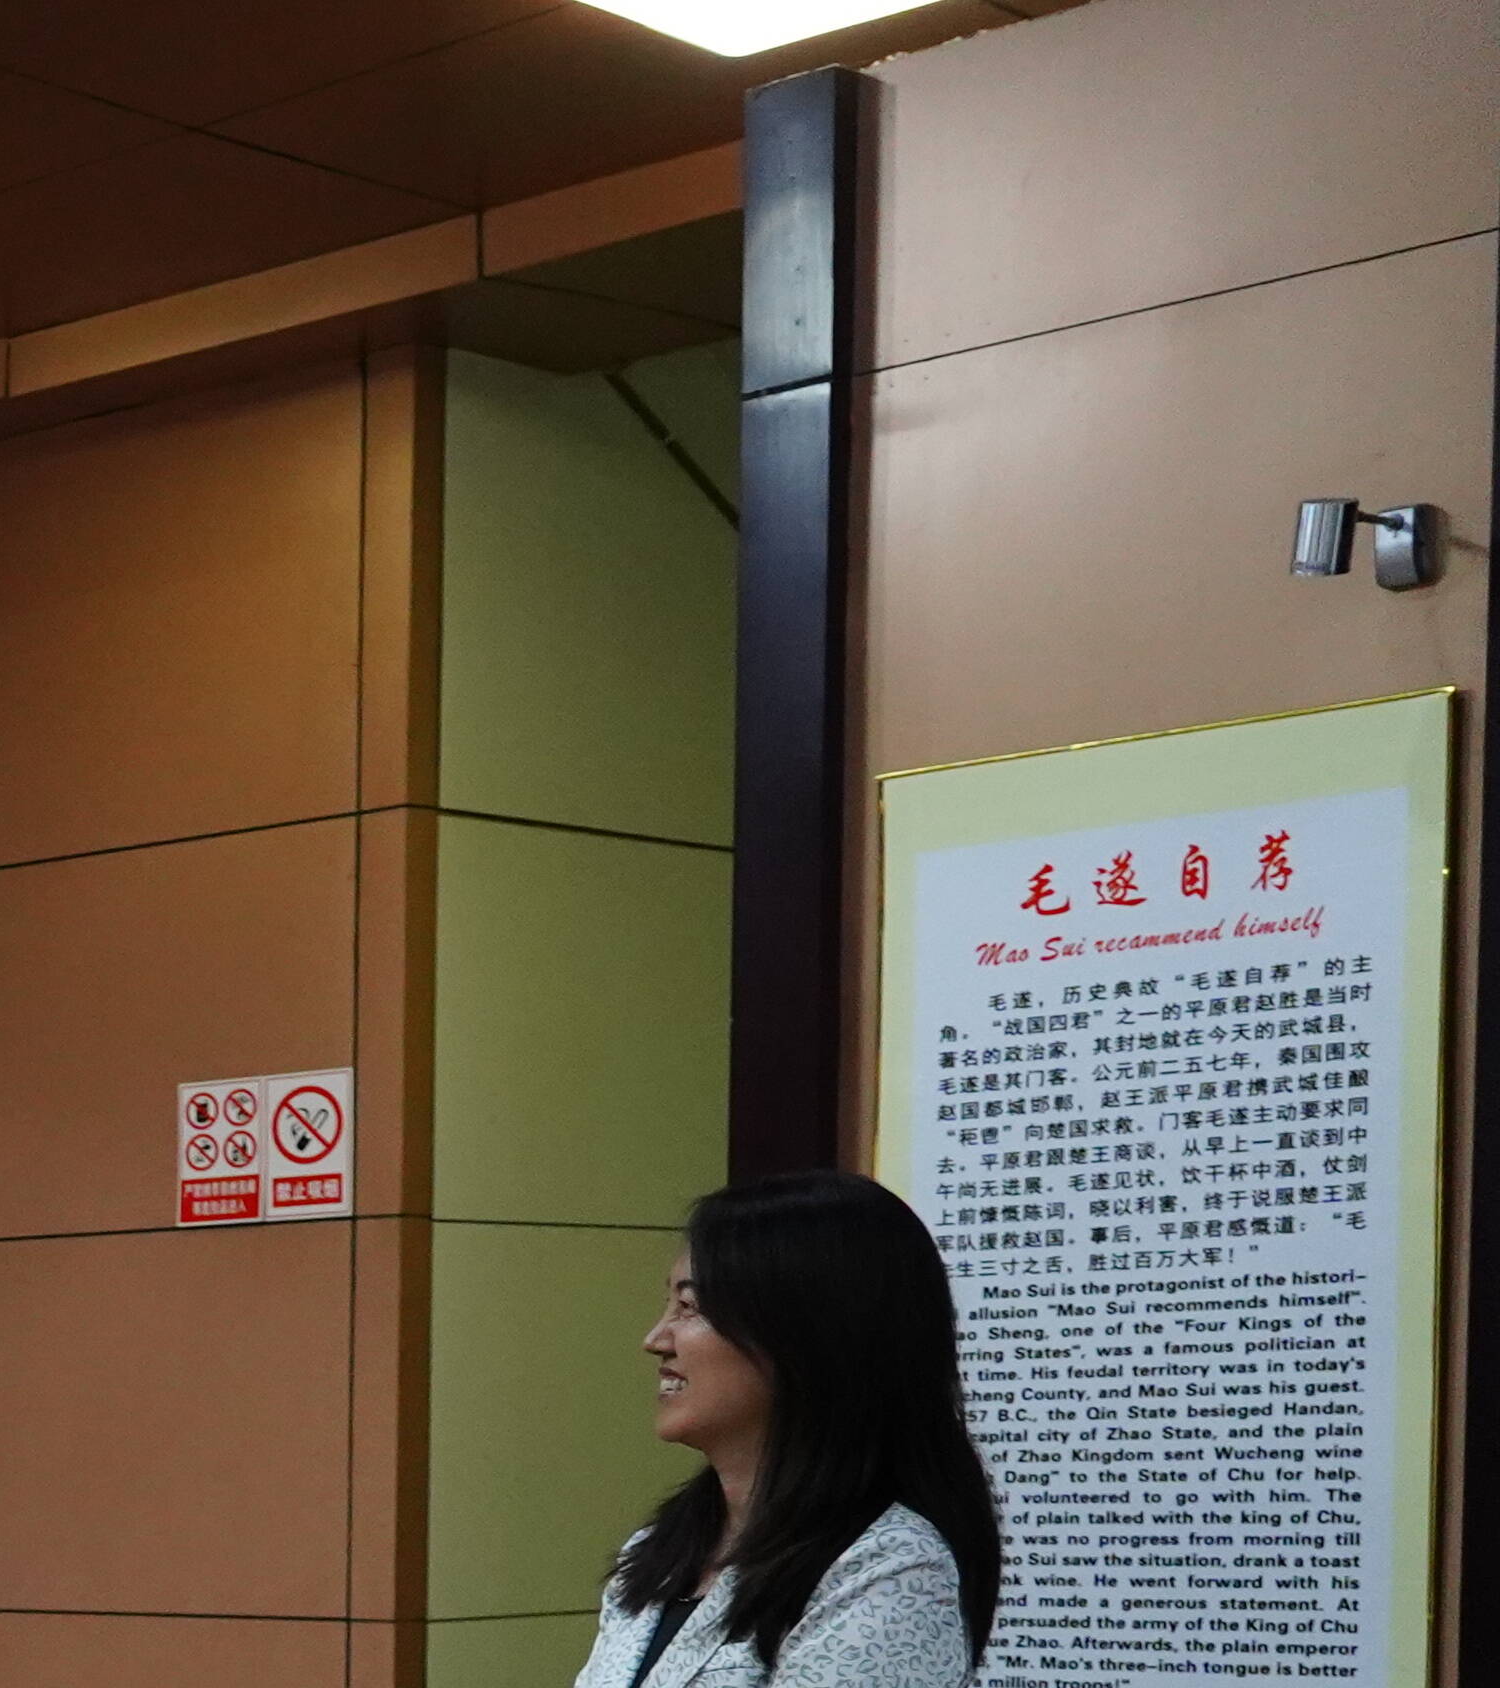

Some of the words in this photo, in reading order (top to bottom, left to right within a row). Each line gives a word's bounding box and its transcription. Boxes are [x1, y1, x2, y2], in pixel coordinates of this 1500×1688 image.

[1019, 830, 1293, 916] 毛遂自荐
[975, 941, 1030, 966] Mao
[1039, 935, 1087, 962] Sui
[1232, 905, 1325, 938] himself
[982, 1285, 1022, 1299] Mao
[1026, 1282, 1055, 1297] Sui
[1060, 1282, 1076, 1296] is
[1080, 1281, 1110, 1295] the
[1114, 1275, 1225, 1296] protagonist
[1229, 1273, 1250, 1288] of
[1254, 1272, 1286, 1287] the
[967, 1305, 1038, 1320] allusion
[1105, 1299, 1135, 1315] Sui
[1144, 1294, 1268, 1313] recommends
[956, 1330, 977, 1341] ao
[1059, 1326, 1094, 1338] one
[1104, 1321, 1123, 1336] of
[1132, 1320, 1164, 1335] the
[1237, 1315, 1292, 1332] Kings
[1303, 1312, 1323, 1328] of
[1333, 1312, 1366, 1327] the
[958, 1347, 1004, 1364] rring
[1095, 1345, 1133, 1357] was
[1142, 1344, 1153, 1355] a
[1163, 1340, 1234, 1354] famous
[1244, 1335, 1335, 1355] politician
[1345, 1335, 1366, 1348] at
[1030, 1365, 1059, 1379] His
[1066, 1363, 1124, 1379] feudal
[1131, 1362, 1210, 1378] territory
[1218, 1362, 1258, 1374] was
[1266, 1358, 1285, 1373] in
[963, 1389, 1015, 1404] cheng
[1097, 1384, 1132, 1399] and
[1137, 1383, 1178, 1398] Mao
[1184, 1381, 1216, 1397] Sui
[1221, 1384, 1262, 1396] was
[1268, 1379, 1297, 1395] his
[965, 1409, 988, 1422] 57
[1045, 1406, 1077, 1421] the
[1085, 1406, 1117, 1420] Qin
[1126, 1404, 1177, 1419] State
[1186, 1401, 1273, 1420] besieged
[1036, 1428, 1070, 1444] city
[1078, 1426, 1097, 1441] of
[1105, 1426, 1152, 1440] Zhao
[1227, 1423, 1263, 1438] and
[1272, 1423, 1305, 1438] the
[1314, 1421, 1363, 1440] plain
[990, 1449, 1008, 1463] of
[1016, 1448, 1062, 1463] Zhao
[1070, 1447, 1154, 1465] Kingdom
[1163, 1447, 1204, 1461] sent
[1213, 1445, 1305, 1462] Wucheng
[1314, 1444, 1363, 1459] wine
[1068, 1471, 1088, 1483] to
[1097, 1469, 1127, 1483] the
[1137, 1468, 1188, 1482] State
[1198, 1467, 1218, 1482] of
[1227, 1467, 1264, 1482] Chu
[1275, 1466, 1304, 1481] for
[994, 1490, 1009, 1505] ui
[1020, 1489, 1130, 1504] volunteered
[1142, 1491, 1162, 1503] to
[1175, 1492, 1199, 1507] go
[1211, 1488, 1255, 1503] with
[1324, 1487, 1362, 1502] The
[1011, 1510, 1030, 1524] of
[1035, 1510, 1080, 1527] plain
[1087, 1510, 1144, 1525] talked
[1150, 1510, 1194, 1525] with
[1200, 1509, 1233, 1525] the
[1239, 1509, 1281, 1527] king
[1289, 1509, 1310, 1524] of
[1021, 1535, 1059, 1545] was
[1066, 1535, 1090, 1545] no
[1097, 1534, 1180, 1549] progress
[1188, 1531, 1233, 1546] from
[1243, 1531, 1325, 1549] morning
[1334, 1531, 1361, 1546] till
[1001, 1555, 1023, 1566] ao
[1027, 1551, 1056, 1566] Sui
[1061, 1555, 1098, 1566] saw
[1103, 1552, 1133, 1567] the
[1232, 1552, 1287, 1568] drank
[1293, 1557, 1304, 1568] a
[1309, 1554, 1360, 1568] toast
[1092, 1573, 1118, 1587] He
[1128, 1575, 1176, 1588] went
[1187, 1574, 1263, 1589] forward
[1274, 1574, 1319, 1590] with
[1330, 1575, 1360, 1590] his
[1037, 1594, 1088, 1608] made
[1098, 1597, 1109, 1608] a
[1120, 1598, 1207, 1612] generous
[1336, 1597, 1359, 1612] At
[997, 1614, 1091, 1629] persuaded
[1095, 1615, 1126, 1629] the
[1131, 1619, 1179, 1633] army
[1184, 1616, 1204, 1631] of
[1208, 1617, 1239, 1631] the
[1244, 1617, 1289, 1635] King
[1294, 1618, 1315, 1633] of
[1319, 1618, 1358, 1634] Chu
[1184, 1637, 1216, 1652] the
[1221, 1639, 1269, 1656] plain
[1274, 1643, 1358, 1658] emperor
[1201, 1661, 1271, 1677] tongue
[1275, 1661, 1292, 1676] is
[1297, 1662, 1358, 1677] better
